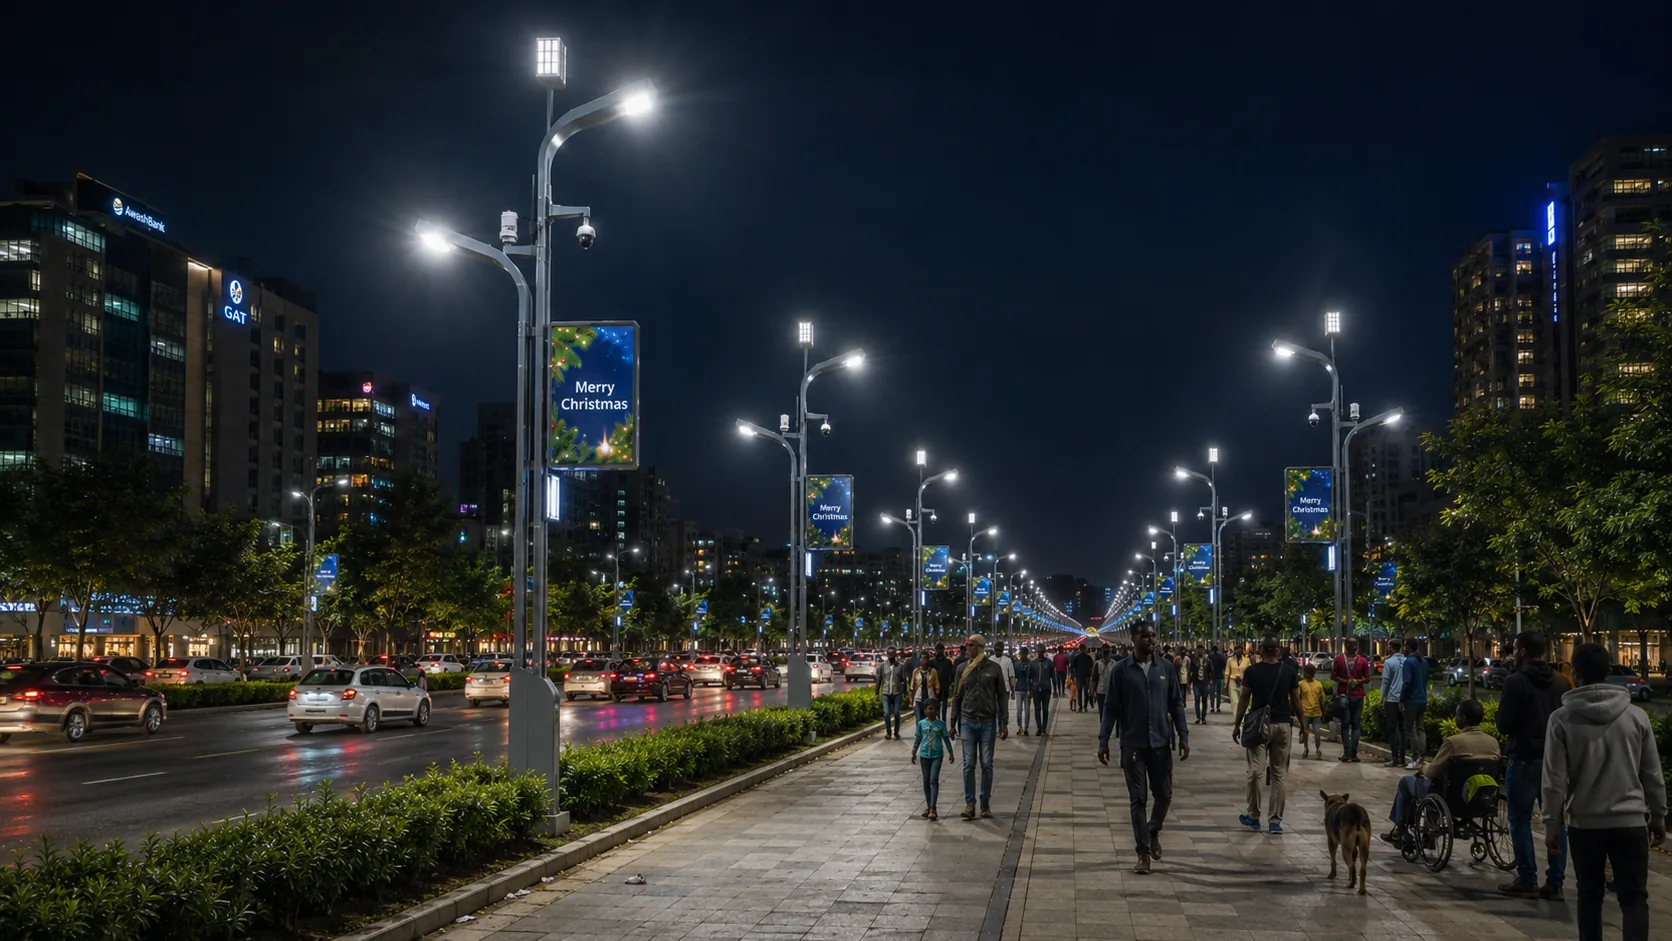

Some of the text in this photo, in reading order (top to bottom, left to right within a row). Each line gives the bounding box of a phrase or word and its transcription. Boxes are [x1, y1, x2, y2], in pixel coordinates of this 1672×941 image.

[224, 305, 247, 325] GAT
[575, 381, 615, 396] Merry
[561, 398, 628, 410] Christmas
[1299, 497, 1322, 505] Merry
[819, 504, 841, 513] Merry
